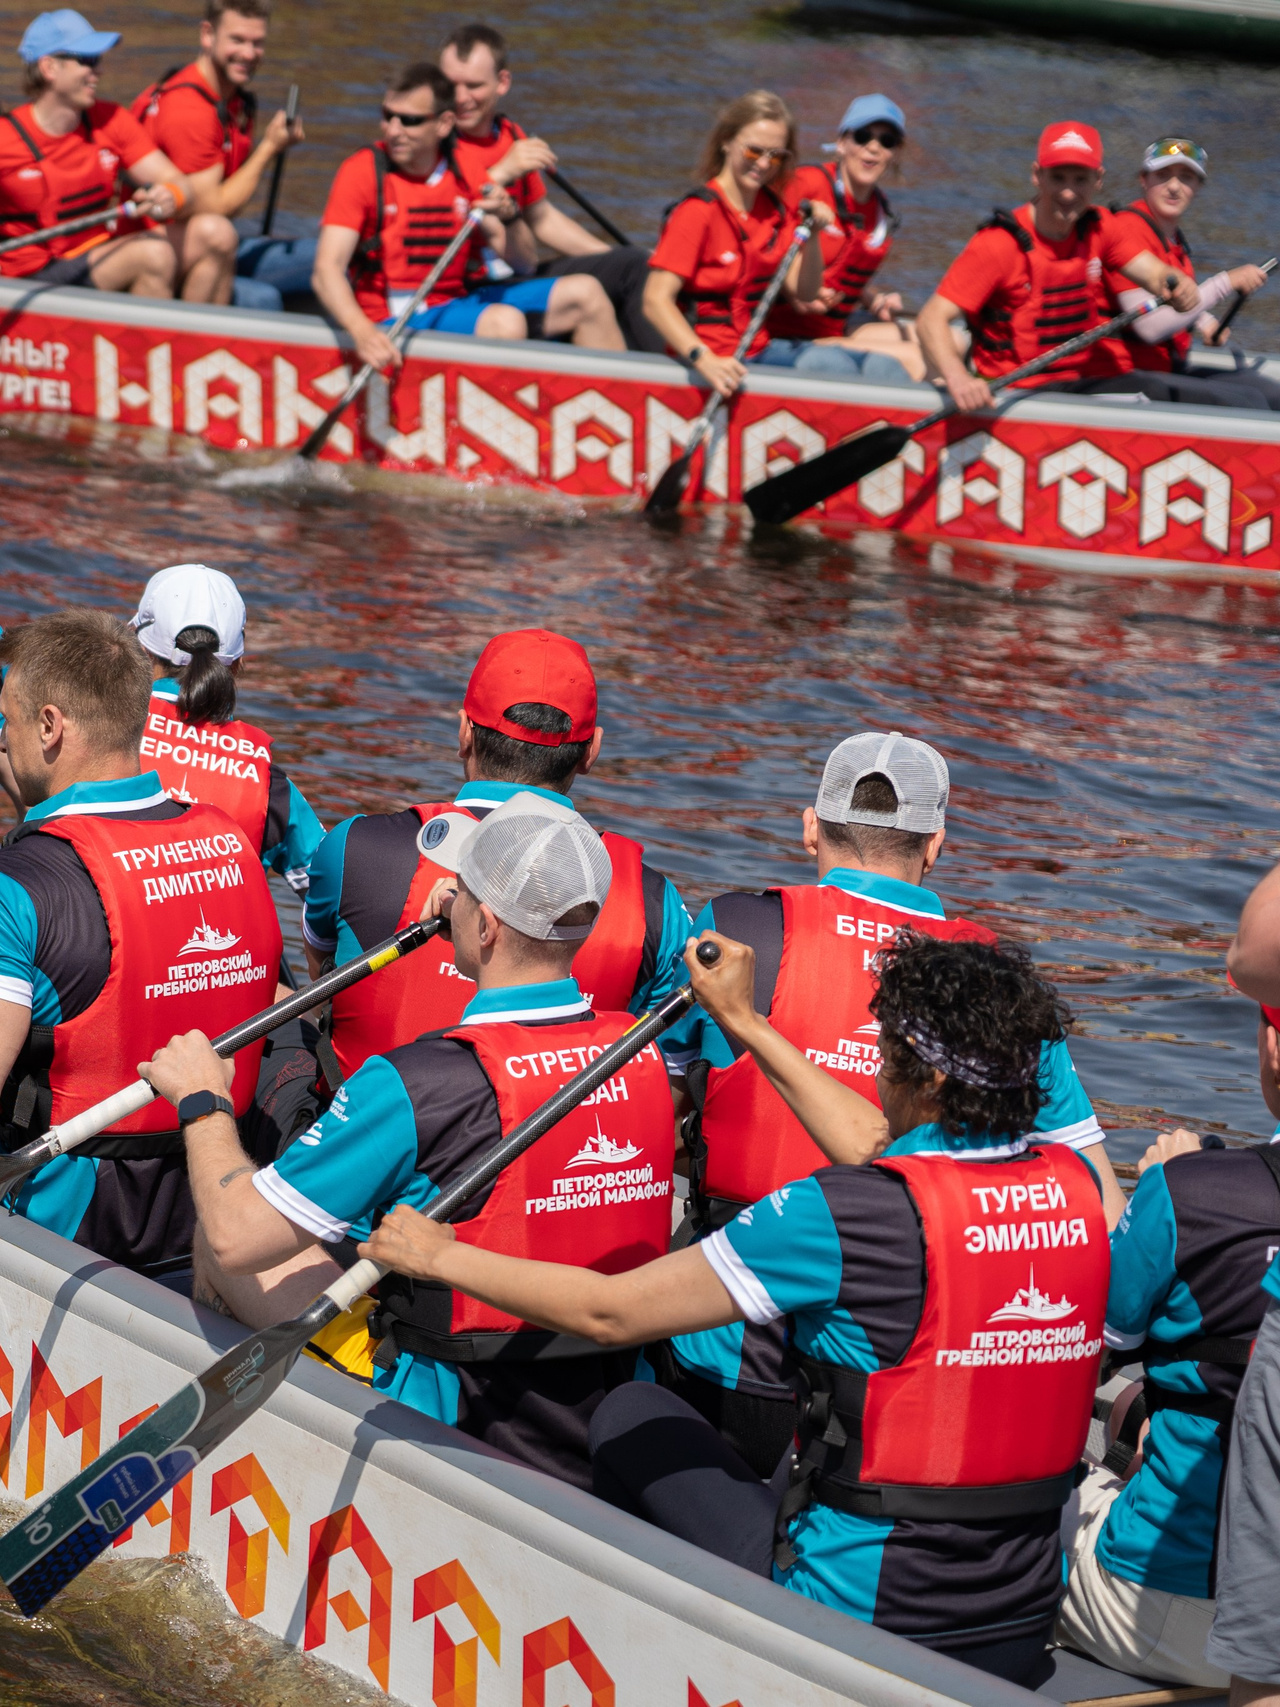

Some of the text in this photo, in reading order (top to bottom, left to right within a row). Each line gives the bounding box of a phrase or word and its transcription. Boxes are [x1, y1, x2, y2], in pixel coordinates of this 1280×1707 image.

[148, 712, 271, 763] ЕПАНОВА
[139, 735, 261, 783] ЕРОНИКА
[112, 833, 244, 873] ТРУНЕНКОВ
[142, 858, 245, 906] ДМИТРИЙ
[144, 965, 267, 999] ГРЕБНОЙ МАРАФОН
[167, 950, 252, 982] ПЕТРОВСКИЙ
[505, 1042, 659, 1079] СТРЕТОЧ
[552, 1163, 654, 1195] ПЕТРОВСКИЙ
[971, 1177, 1068, 1215] ТУРЕЙ
[525, 1180, 670, 1215] ГРЕБНОЙ МАРАФОН
[964, 1218, 1089, 1254] ЭМИЛИЯ
[936, 1337, 1102, 1367] ГРЕБНОЙ МАРАФОН
[970, 1320, 1086, 1349] ПЕТРОВСКИЙ
